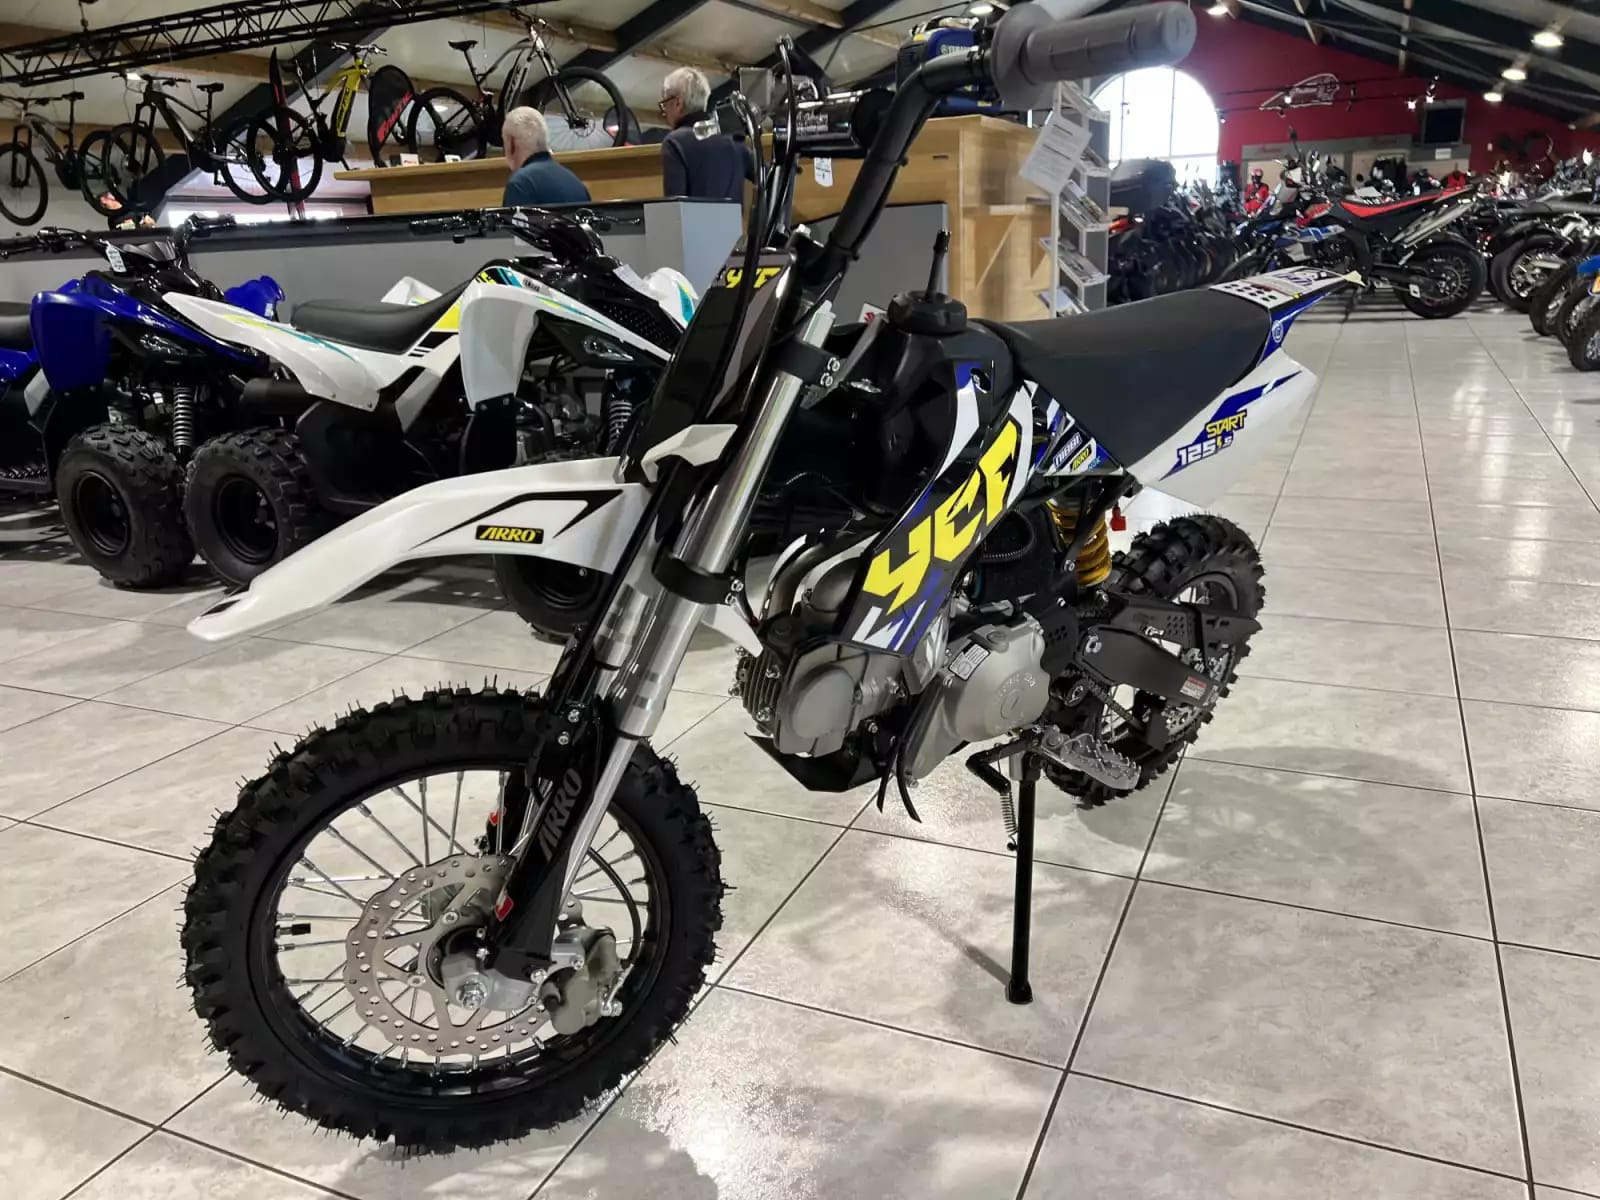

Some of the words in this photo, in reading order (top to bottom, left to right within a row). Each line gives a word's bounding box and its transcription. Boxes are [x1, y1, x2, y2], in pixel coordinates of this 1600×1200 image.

[725, 266, 782, 289] YF
[1206, 411, 1247, 439] START
[480, 526, 537, 543] ARRO
[538, 766, 583, 863] ARRO
